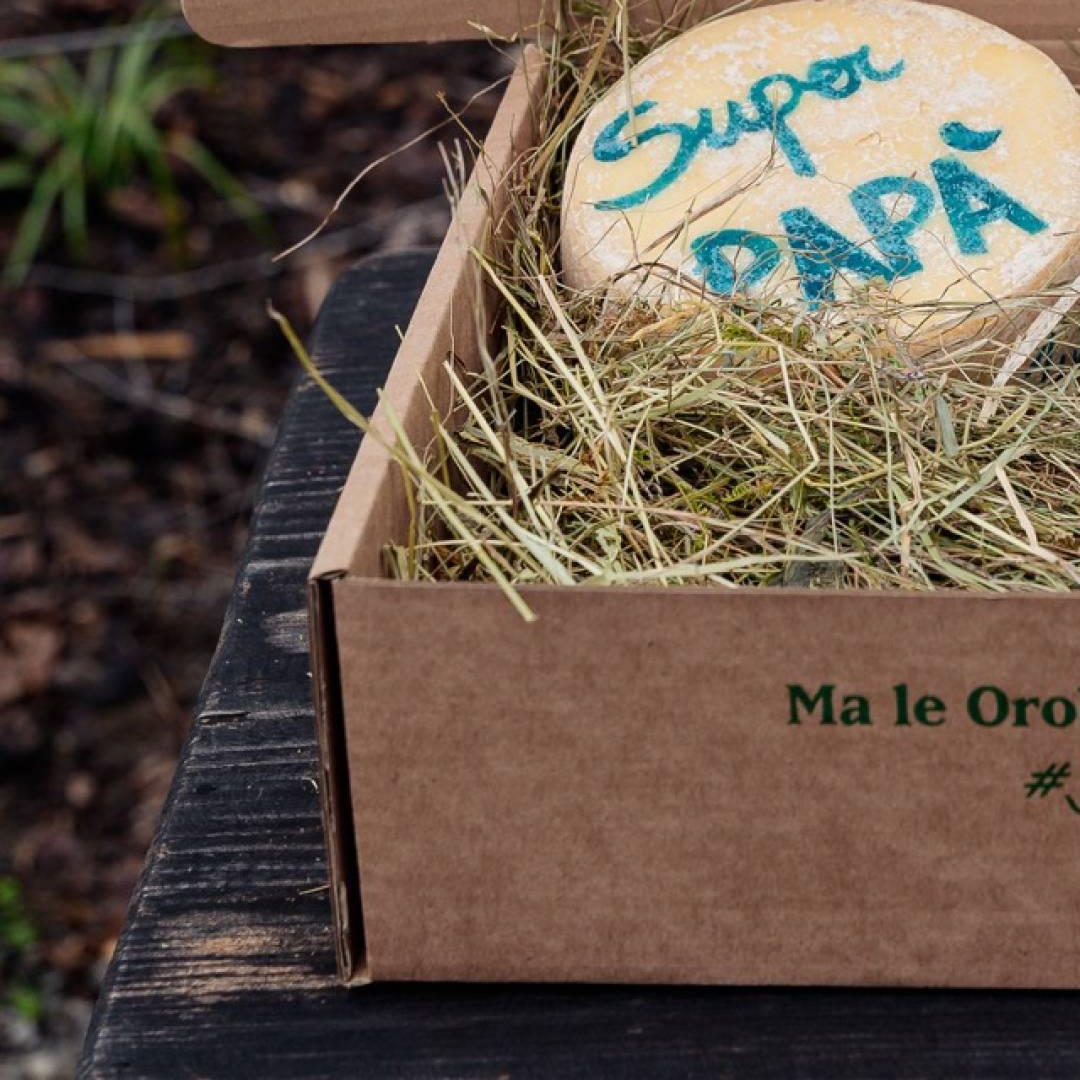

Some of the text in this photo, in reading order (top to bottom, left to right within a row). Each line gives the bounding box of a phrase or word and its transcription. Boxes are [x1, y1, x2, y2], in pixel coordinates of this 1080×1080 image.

[592, 44, 905, 211] Super
[786, 683, 873, 726] Ma
[892, 683, 946, 727] le
